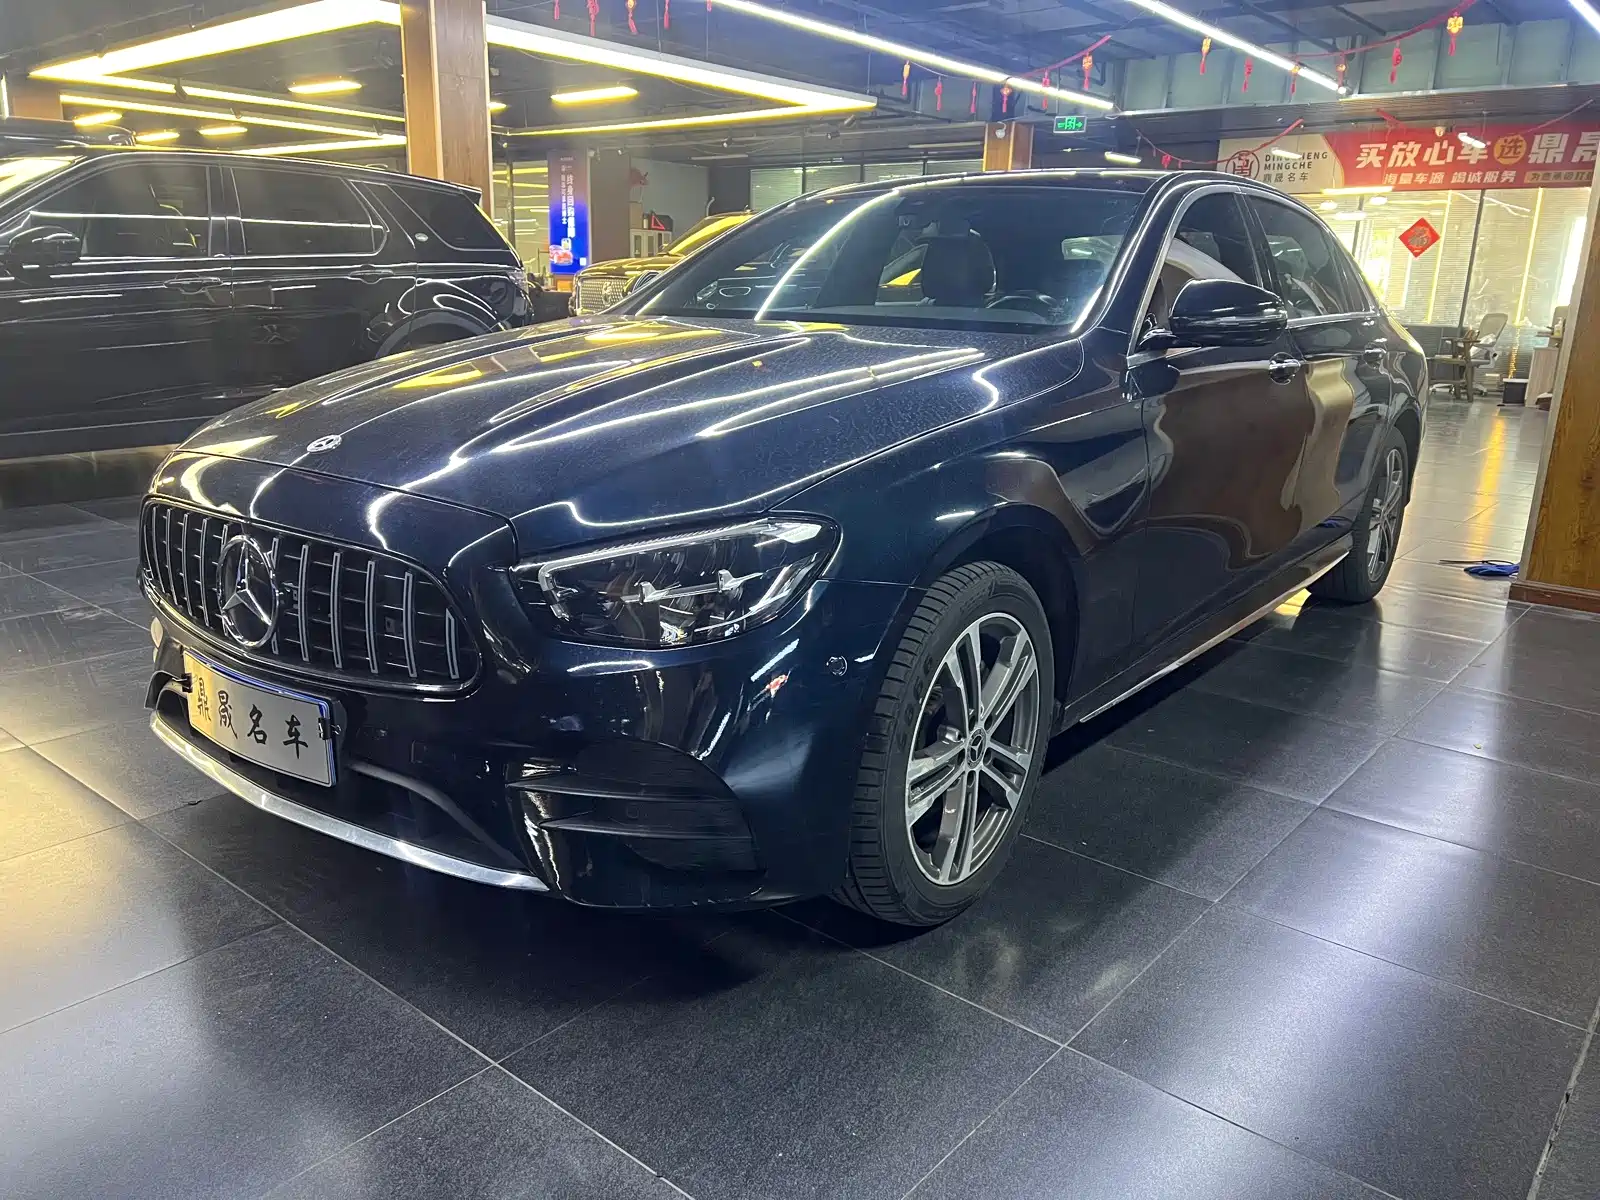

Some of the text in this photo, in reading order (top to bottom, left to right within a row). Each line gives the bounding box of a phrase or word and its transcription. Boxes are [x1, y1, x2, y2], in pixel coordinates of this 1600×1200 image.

[1264, 161, 1312, 171] MINGCHE
[1383, 171, 1445, 185] 海量车源
[196, 677, 309, 759] 鼎晟名车
